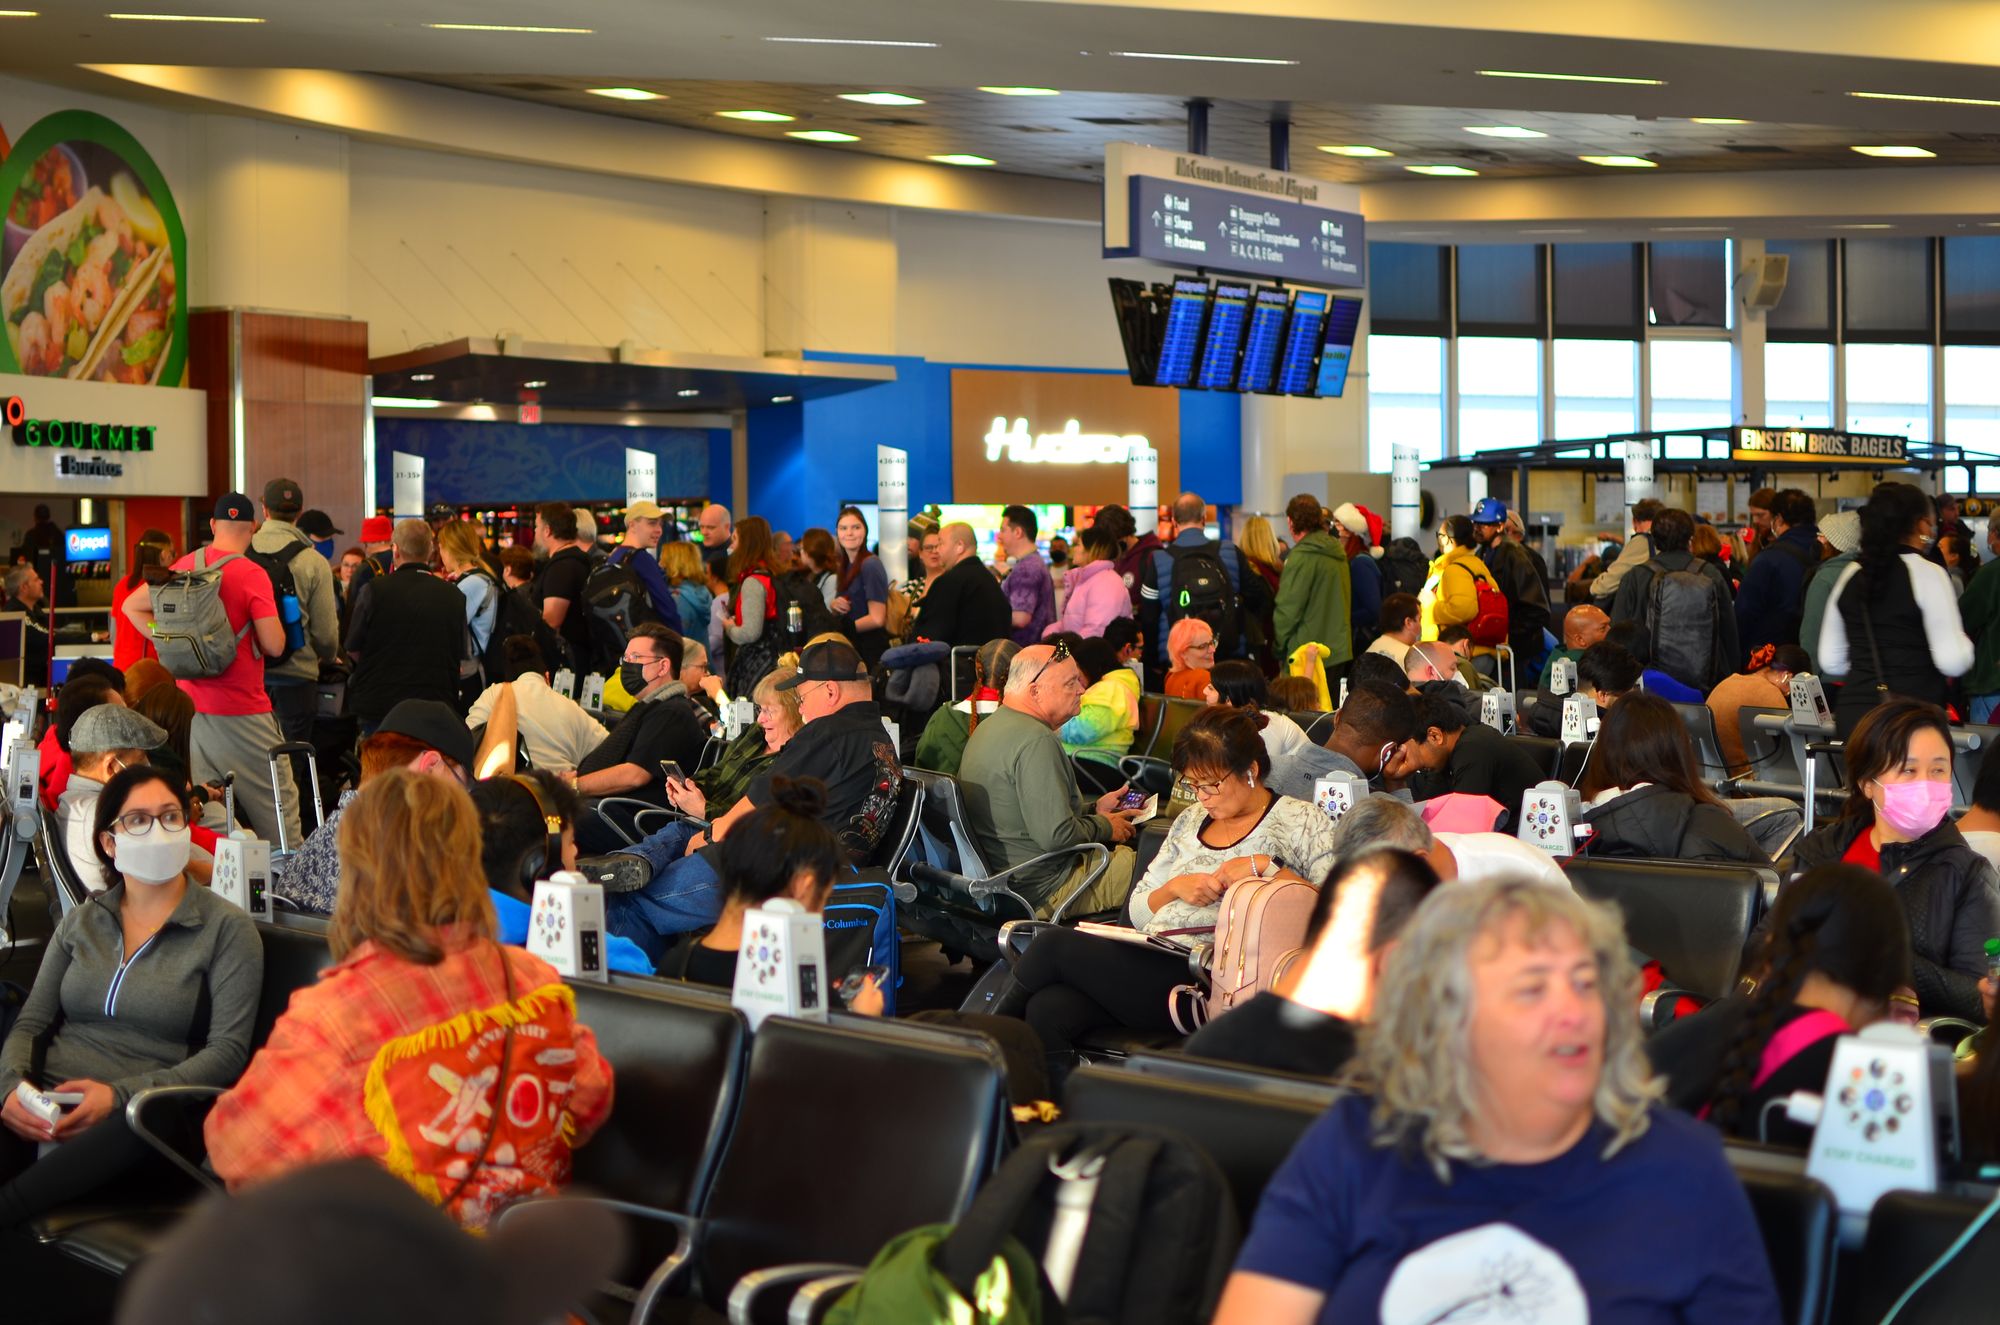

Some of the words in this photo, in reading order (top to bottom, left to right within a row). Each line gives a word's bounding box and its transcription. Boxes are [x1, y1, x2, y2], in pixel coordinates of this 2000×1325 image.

[26, 418, 157, 452] GOURMET
[983, 416, 1150, 463] Hudson
[1741, 429, 1807, 453] EINSTEIN
[1809, 433, 1847, 455] BROS.
[1850, 436, 1903, 458] BAGELS
[62, 454, 123, 477] Burritos
[79, 534, 108, 551] pepsi
[826, 918, 868, 929] Columbia
